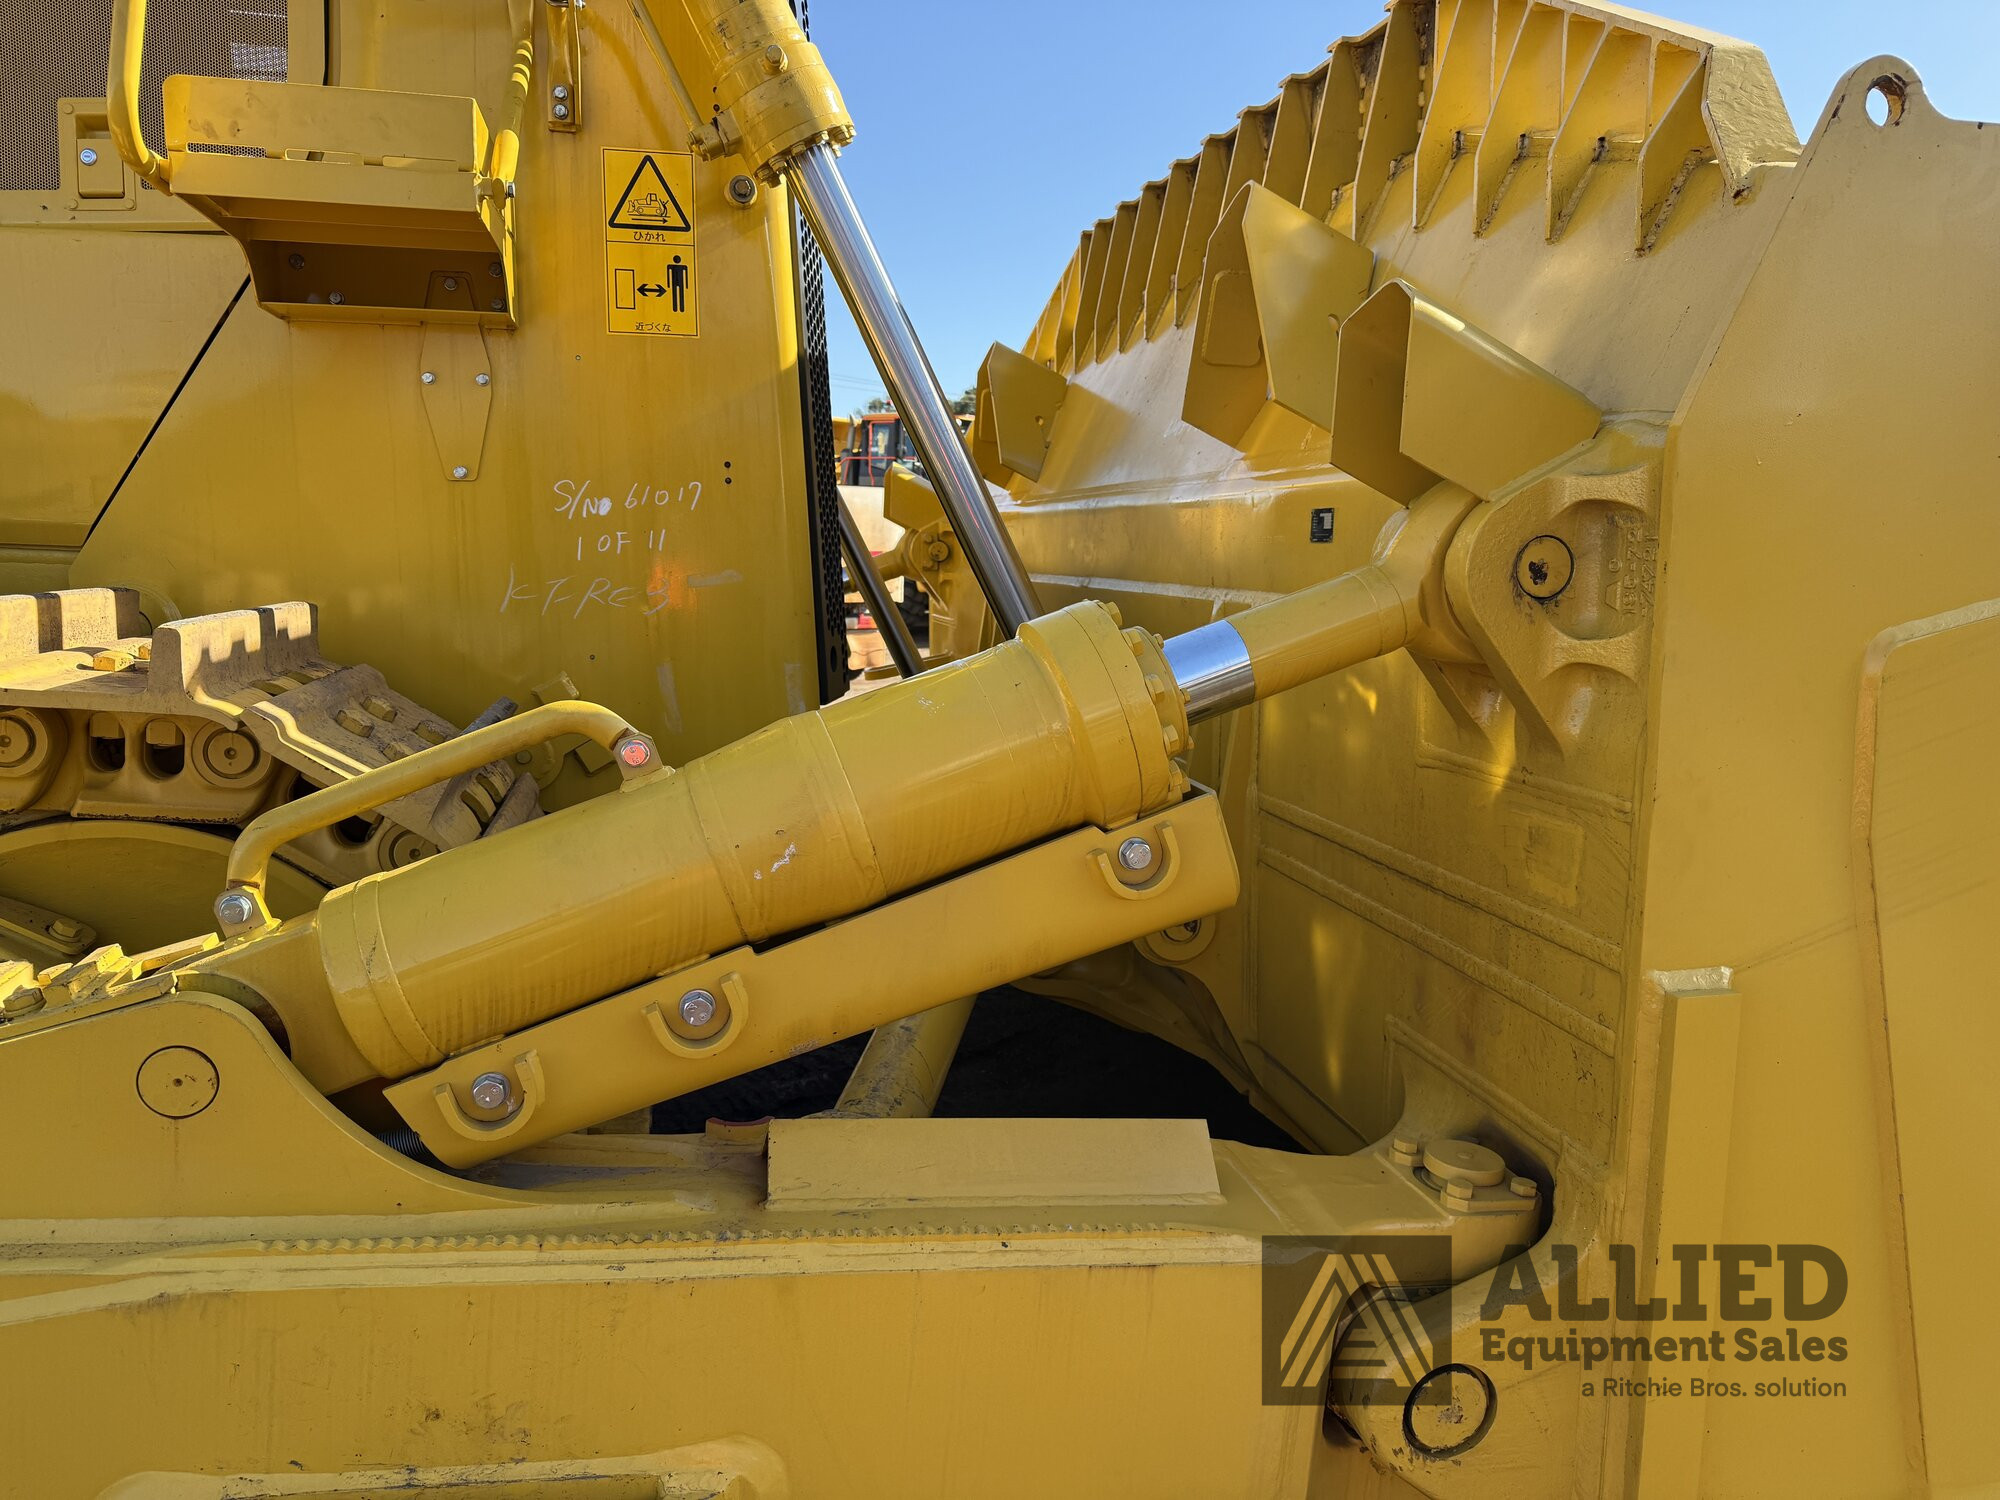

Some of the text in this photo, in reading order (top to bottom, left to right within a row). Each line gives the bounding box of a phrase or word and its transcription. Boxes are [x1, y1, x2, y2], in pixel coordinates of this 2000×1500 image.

[633, 231, 666, 242] ひかれ
[635, 321, 672, 333] 近づくな
[597, 531, 632, 555] OF
[648, 528, 666, 552] 11
